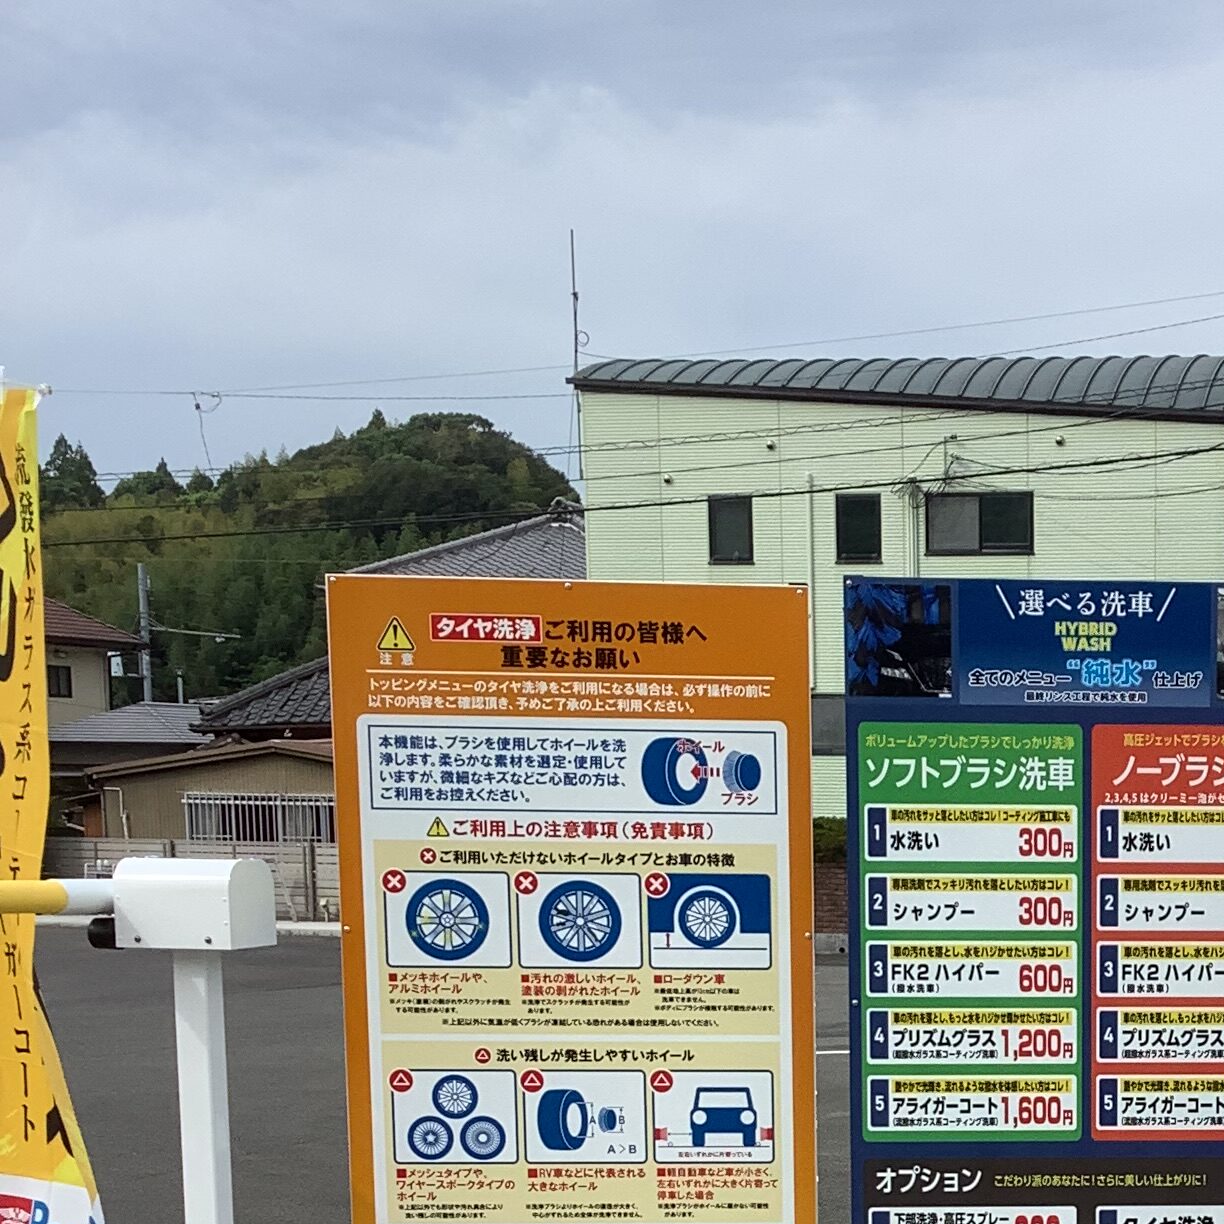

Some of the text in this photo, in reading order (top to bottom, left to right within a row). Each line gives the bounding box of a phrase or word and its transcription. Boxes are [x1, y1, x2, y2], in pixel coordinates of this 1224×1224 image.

[1018, 588, 1154, 618] 選べる洗車
[436, 617, 707, 645] タイヤ洗浄 ご利用の皆様へ
[1054, 621, 1118, 636] HYBRID
[1061, 636, 1112, 652] WASH
[501, 646, 641, 669] 重要なお願い
[968, 668, 1072, 687] 全てのメニュー
[1152, 671, 1204, 689] 仕上げ
[369, 678, 771, 697] トッピングメニューのタイヤ洗浄をご利用になる場合は、必ず操作の前に
[368, 694, 695, 714] 以下の内容をご確認頂き、予めご了承の上ご利用ください。
[1024, 689, 1148, 704] 最終リンス工程で純水を使用
[379, 735, 627, 752] 本機能は、ブラシを使用してホイールを洗
[677, 740, 725, 754] ホイール
[865, 733, 1075, 751] ボリュームアップしたブラシでしっかり洗浄
[379, 752, 627, 770] 浄します。柔らかな素材を選定・使用して
[380, 771, 626, 787] いますが、微細なキズなどご心配の方は、
[866, 757, 1076, 792] ソフトブラシ洗車
[380, 787, 531, 803] ご利用をお控えください。
[721, 792, 759, 806] ブラシ
[1104, 793, 1138, 804] 2,3,4,5
[452, 820, 714, 840] ご利用上の注意事項（免責事項）
[873, 824, 881, 841] 1
[890, 827, 1074, 859] 水洗い 300円
[1122, 832, 1171, 852] 水洗い
[439, 850, 735, 868] ご利用いただけないホイールタイプとお車の特徴
[872, 894, 884, 911] 2
[893, 896, 1074, 927] シャンプー 300円
[1124, 902, 1205, 923] シャンプー
[873, 961, 884, 977] 3
[1121, 964, 1159, 981] FK2
[399, 972, 488, 984] メッキホイールや、
[530, 973, 642, 985] 汚れの激しいホイール、
[663, 974, 726, 985] ローダウン車
[891, 963, 1074, 994] FK2 ハイパー 600円
[388, 983, 462, 995] アルミホイール
[521, 985, 641, 997] 塗装の剥がれたホイール
[874, 1027, 885, 1044] 4
[1121, 1027, 1224, 1047] プリズムグラス
[892, 1027, 1073, 1062] プリズムグラス 1,200円
[496, 1049, 695, 1063] 洗い残しが発生しやすいホイール
[875, 1095, 885, 1112] 5
[893, 1096, 1073, 1128] アライガーコート 1,600円
[407, 1168, 488, 1179] メッシュタイプや、
[539, 1168, 646, 1179] RV車などに代表される
[667, 1167, 773, 1177] 軽自動車など車が小さく、
[875, 1165, 983, 1194] オプション
[396, 1180, 515, 1191] ワイヤースポークタイプの
[527, 1181, 598, 1192] 大きなホイール
[656, 1179, 779, 1189] 左右いずれかに大きく片寄って
[397, 1191, 437, 1202] ホイール
[657, 1190, 715, 1201] 停車した場合
